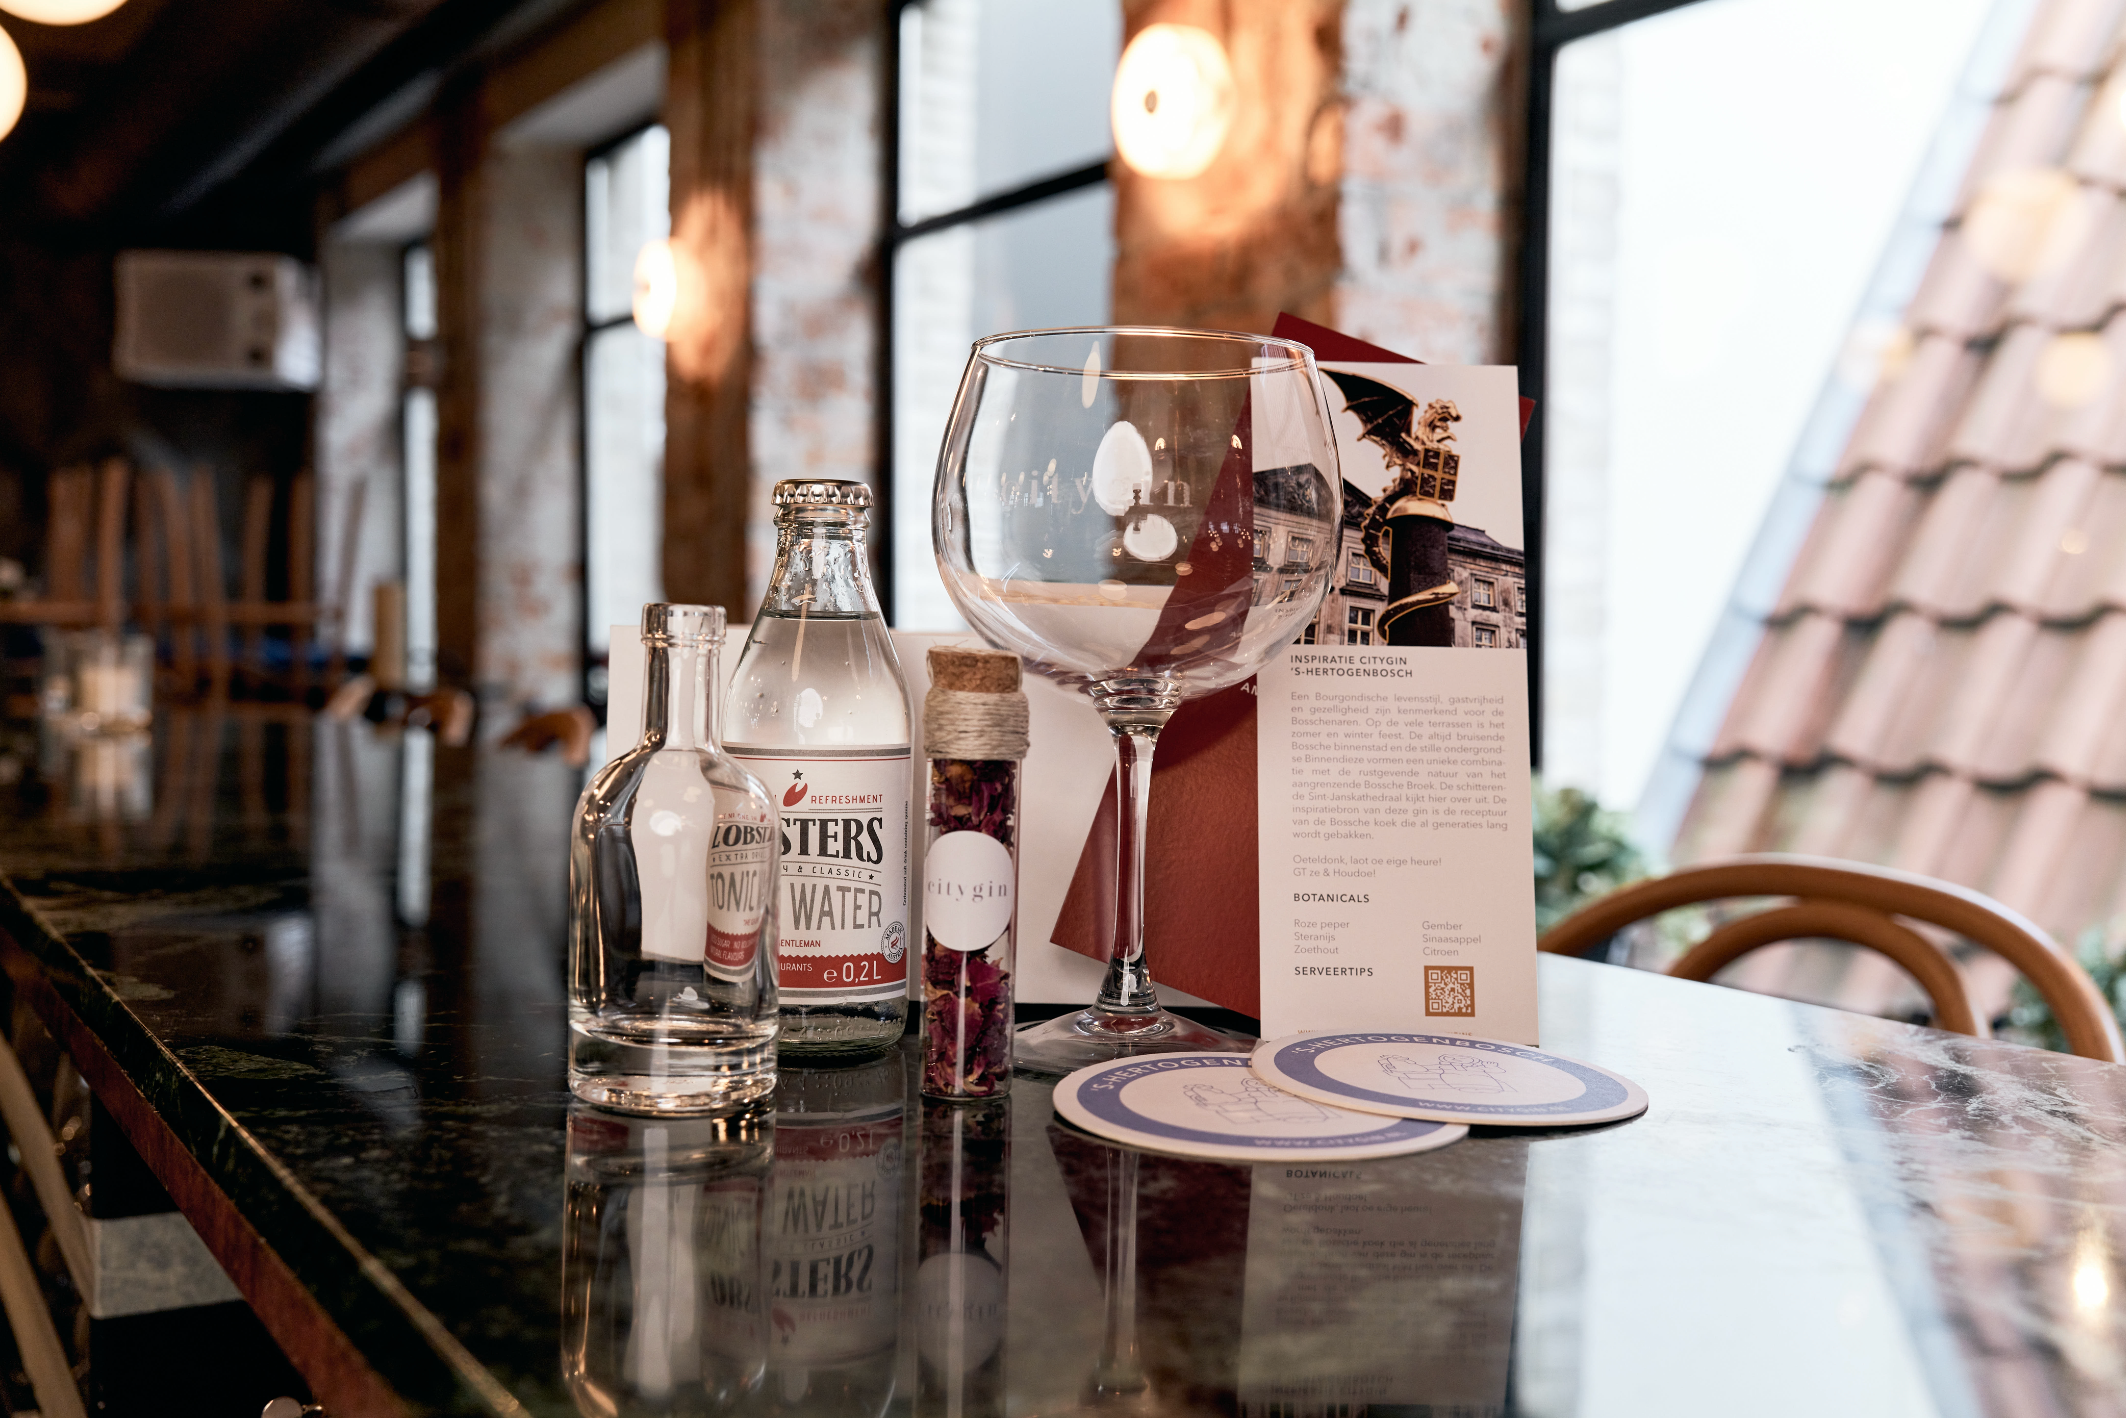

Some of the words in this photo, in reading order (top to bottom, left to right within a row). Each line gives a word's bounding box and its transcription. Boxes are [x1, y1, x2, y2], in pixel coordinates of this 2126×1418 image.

[1291, 655, 1355, 664] INSPIRATIE
[1359, 656, 1407, 665] CITYGIN
[1291, 667, 1412, 678] 'S-HERTOGENBOSCH
[1291, 692, 1309, 700] Een
[1315, 692, 1388, 703] Bourgondische
[1394, 694, 1442, 705] levensstijl,
[1448, 695, 1504, 706] gastvrijheid
[1309, 705, 1368, 716] gezelligheid
[1375, 706, 1391, 716] zijn
[1398, 706, 1457, 716] kenmerkend
[1492, 708, 1504, 717] de
[1292, 717, 1360, 726] Bosschenaren.
[1366, 718, 1382, 731] Op
[1386, 718, 1399, 727] de
[1404, 719, 1424, 727] vele
[1428, 720, 1472, 728] terrassen
[1489, 720, 1504, 729] het
[1344, 731, 1373, 739] winter
[1379, 730, 1404, 739] feest.
[1409, 731, 1423, 740] De
[1428, 732, 1451, 742] altijd
[1457, 732, 1505, 741] bruisende
[1292, 741, 1331, 750] Bossche
[1334, 742, 1387, 751] binnenstad
[1405, 744, 1417, 752] de
[1420, 744, 1441, 753] stille
[1444, 745, 1505, 756] ondergrond-
[1305, 754, 1364, 763] Binnendieze
[1427, 757, 1458, 765] unieke
[1461, 758, 1505, 766] combina-
[1292, 767, 1304, 775] tie
[1338, 767, 1351, 776] de
[1359, 768, 1419, 779] rustgevende
[1428, 770, 1458, 778] natuur
[1491, 770, 1506, 779] het
[1292, 780, 1361, 790] aangrenzende
[1364, 780, 1404, 789] Bossche
[1407, 781, 1437, 790] Broek.
[1440, 782, 1454, 790] De
[1456, 782, 1506, 791] schitteren-
[811, 794, 883, 804] REFRESHMENT
[1292, 791, 1304, 800] de
[1309, 792, 1402, 802] Sint-Janskathedraal
[1406, 793, 1425, 804] kijkt
[1429, 794, 1447, 803] hier
[1493, 795, 1507, 804] De
[1293, 805, 1359, 815] inspiratiebron
[1385, 806, 1408, 815] deze
[1413, 807, 1428, 817] gin
[1432, 807, 1439, 815] is
[1444, 807, 1456, 815] de
[1461, 809, 1507, 818] receptuur
[1313, 817, 1326, 826] de
[1330, 817, 1370, 826] Bossche
[1374, 818, 1397, 827] koek
[1401, 819, 1416, 827] die
[1420, 819, 1428, 828] al
[1432, 821, 1483, 830] generaties
[1487, 820, 1508, 831] lang
[1293, 830, 1321, 838] wordt
[1324, 830, 1374, 841] gebakken.
[1293, 855, 1347, 867] Oeteldonk,
[1351, 856, 1368, 866] laot
[1386, 857, 1408, 867] eige
[1411, 856, 1441, 866] heure!
[812, 866, 863, 879] CLASSIC
[1293, 868, 1307, 876] GT
[1323, 868, 1330, 877] &
[1333, 868, 1375, 877] Houdoe!
[710, 871, 757, 912] TONIC
[927, 877, 1009, 903] citygin
[1294, 893, 1369, 903] BOTANICALS
[790, 882, 882, 930] WATER
[1294, 919, 1317, 928] Roze
[1321, 922, 1350, 933] peper
[1422, 921, 1462, 930] Gember
[1294, 932, 1335, 943] Steranijs
[1422, 934, 1481, 946] Sinaasappel
[1294, 945, 1338, 954] Zoethout
[1423, 947, 1459, 956] Citroen
[1295, 966, 1373, 977] SERVEERTIPS
[1090, 1058, 1252, 1091] 'S-HERTOGEN
